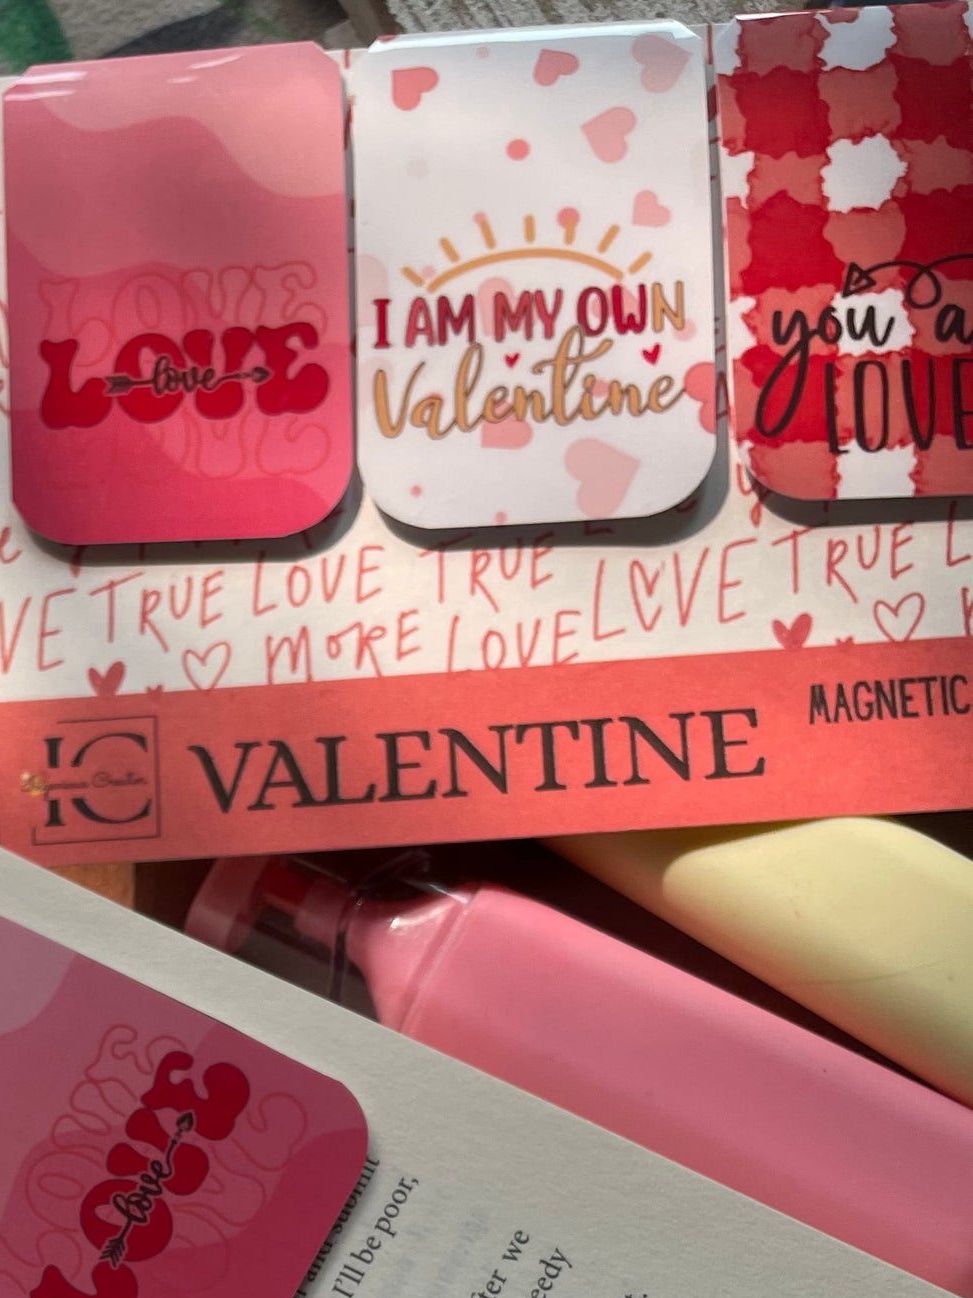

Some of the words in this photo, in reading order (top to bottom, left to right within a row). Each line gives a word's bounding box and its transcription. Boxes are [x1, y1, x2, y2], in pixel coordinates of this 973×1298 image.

[372, 298, 390, 349] I
[405, 294, 475, 347] AM
[493, 288, 563, 342] MY
[577, 280, 685, 338] OWN
[39, 321, 330, 430] LOVE
[373, 324, 686, 440] Valentine
[755, 305, 895, 438] you
[89, 570, 225, 653] TRUE
[252, 545, 385, 617] LOVE
[418, 530, 554, 613] TRUE
[770, 520, 915, 604] TRUE
[266, 608, 422, 687] MORE
[187, 707, 766, 814] VALENTINE
[809, 674, 971, 725] MAGNETIC
[349, 1236, 382, 1265] be
[374, 1177, 419, 1238] poor,
[502, 1230, 530, 1261] we
